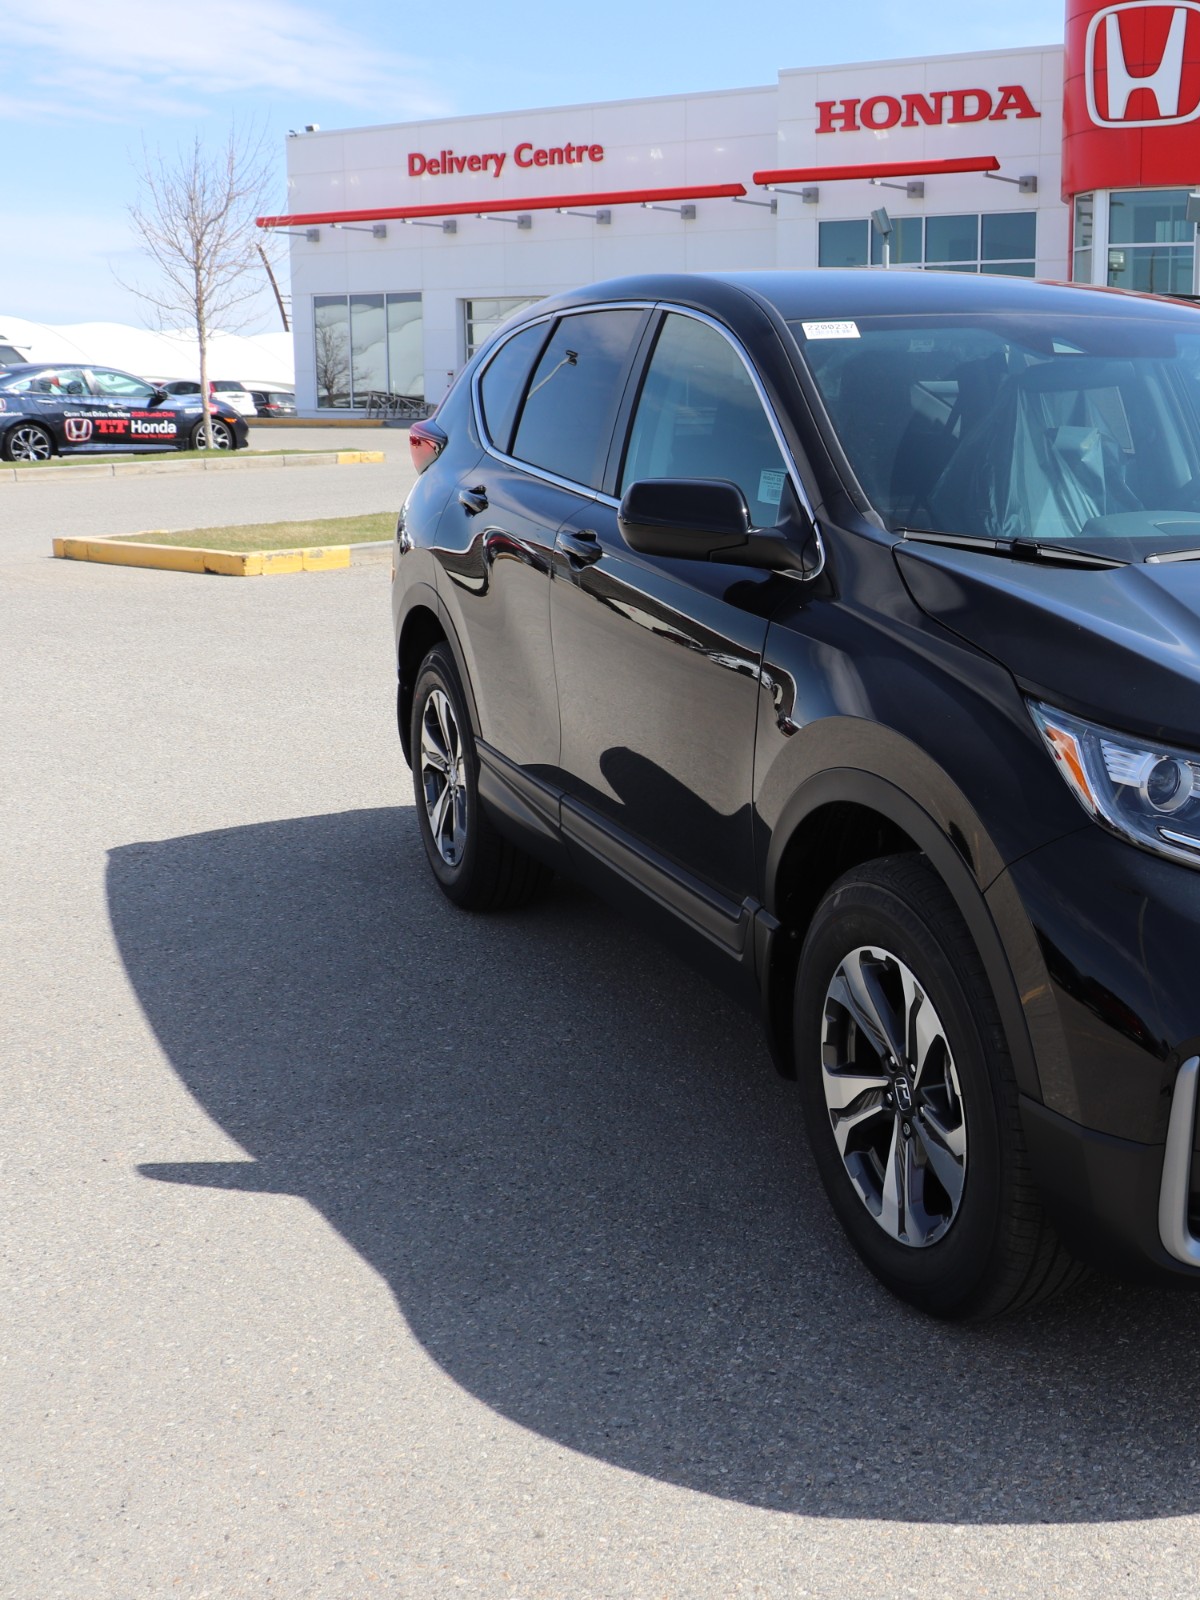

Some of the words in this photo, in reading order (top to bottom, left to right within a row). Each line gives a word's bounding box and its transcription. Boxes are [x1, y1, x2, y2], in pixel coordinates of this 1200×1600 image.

[815, 85, 1041, 134] HONDA
[407, 150, 506, 177] Delivery
[513, 142, 604, 168] Centre
[131, 419, 177, 434] Honda
